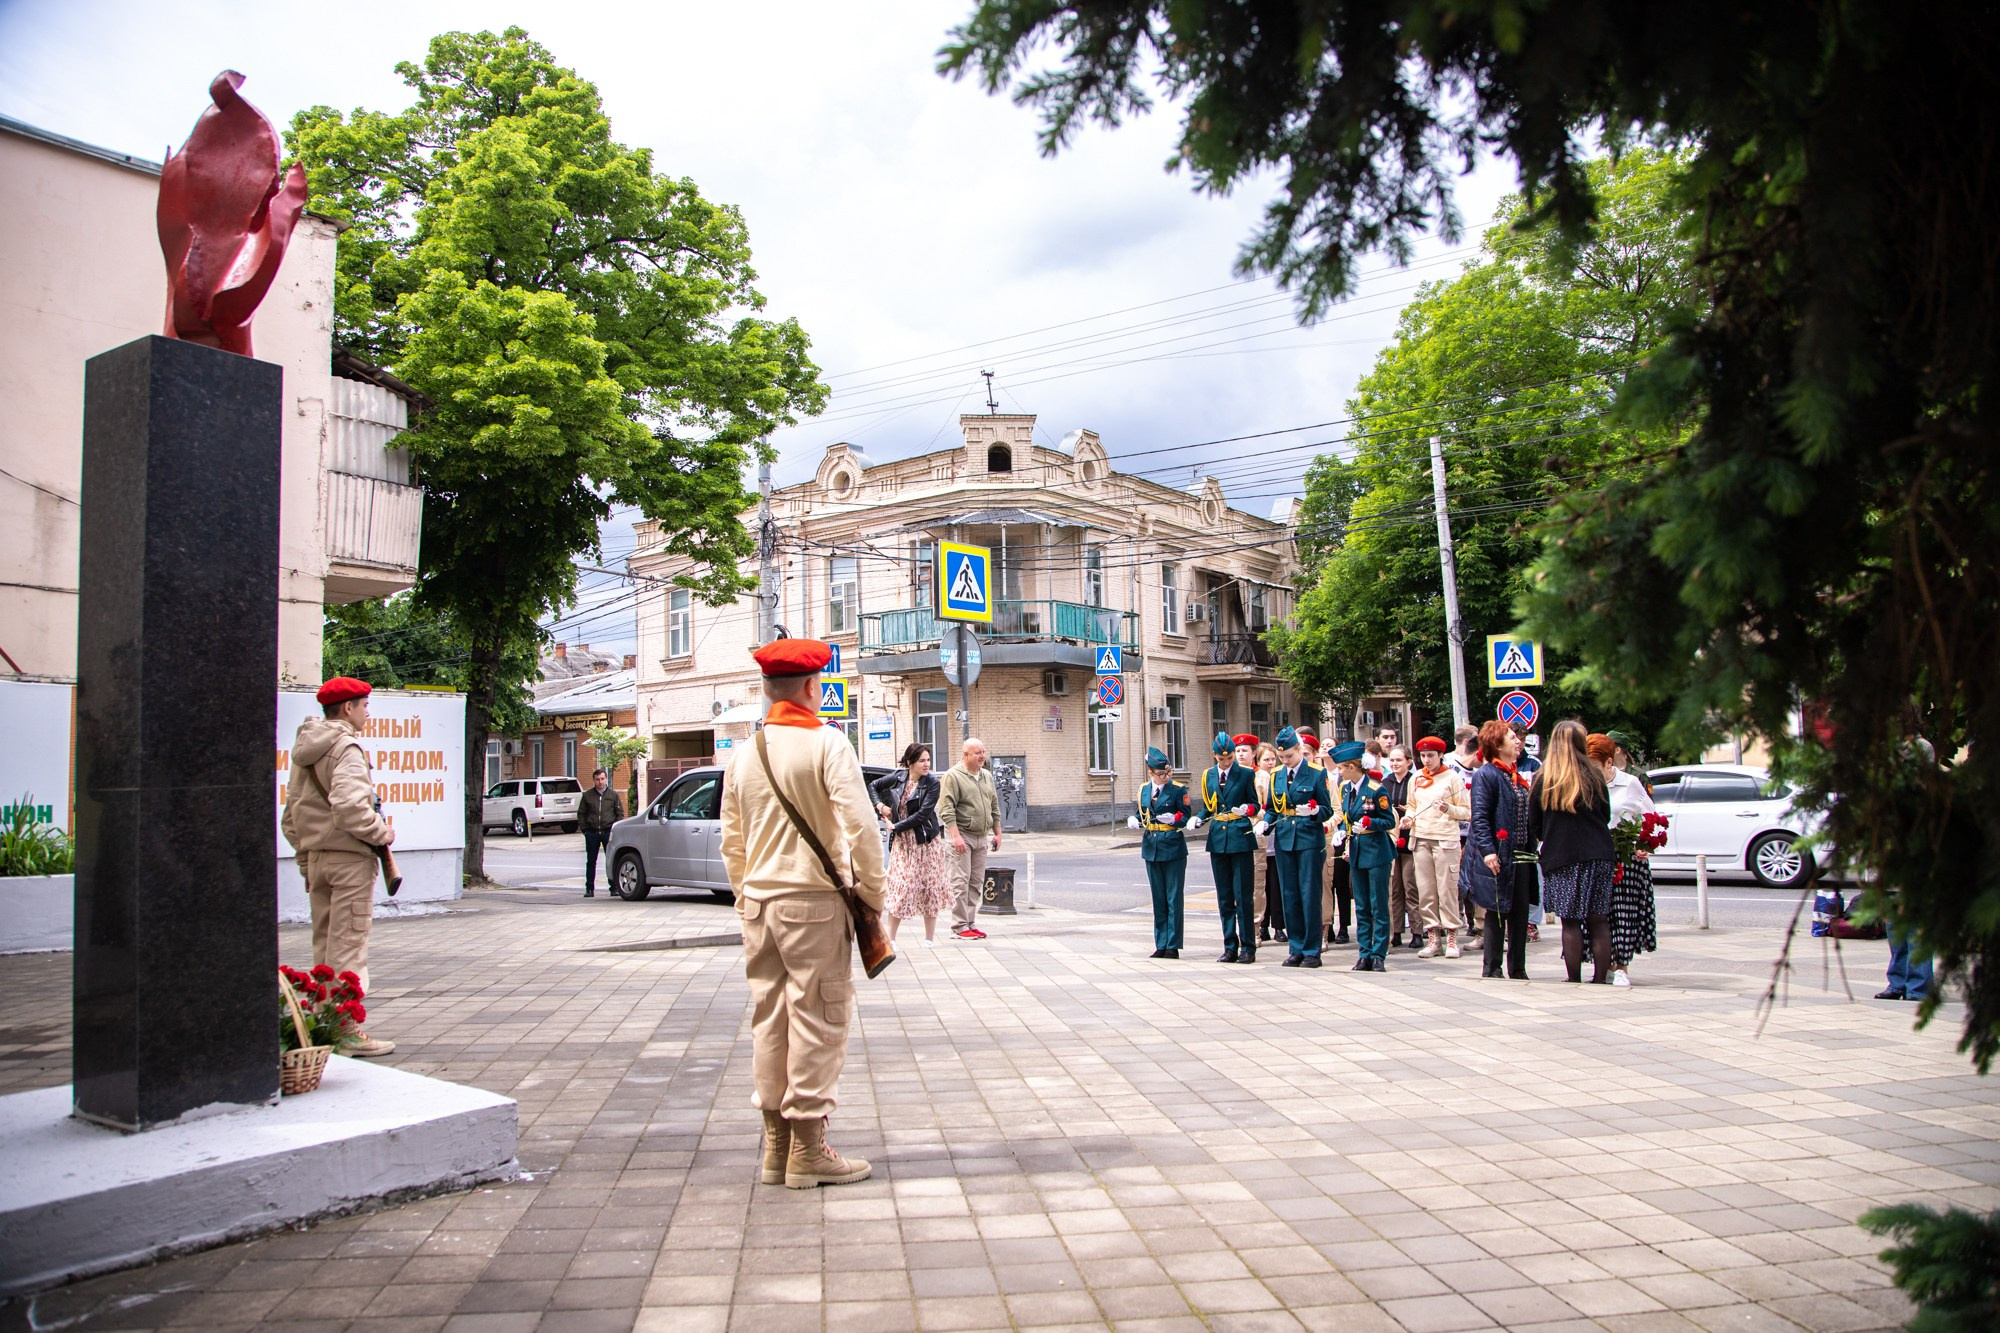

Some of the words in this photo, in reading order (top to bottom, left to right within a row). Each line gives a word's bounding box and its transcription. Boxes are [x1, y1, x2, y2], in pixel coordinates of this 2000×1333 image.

[357, 715, 422, 738] ЖНЫЙ
[376, 750, 448, 773] РЯДОМ,
[372, 778, 444, 805] ОЯЩИЙ
